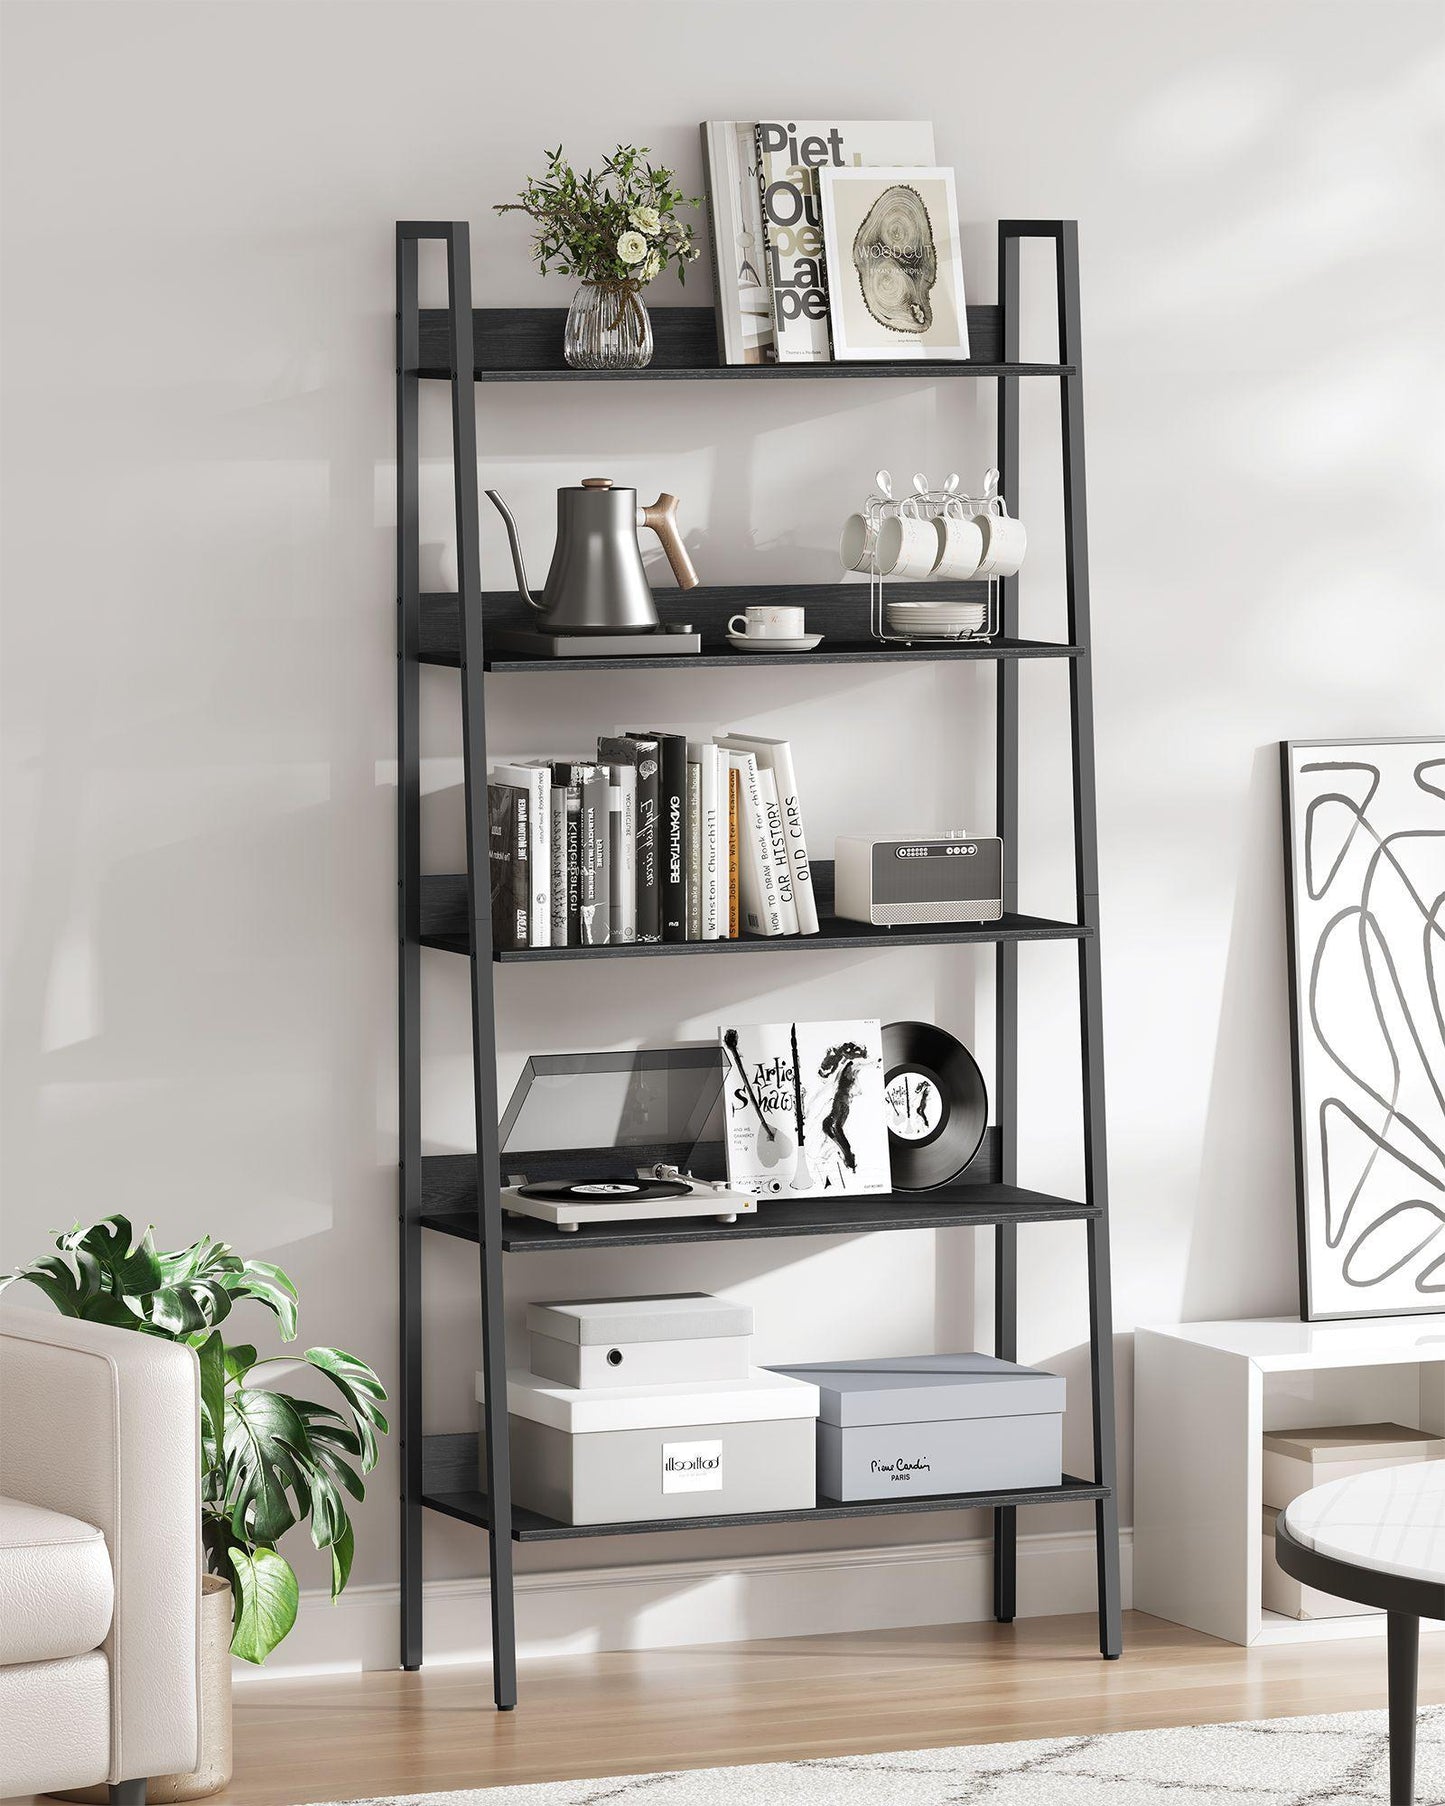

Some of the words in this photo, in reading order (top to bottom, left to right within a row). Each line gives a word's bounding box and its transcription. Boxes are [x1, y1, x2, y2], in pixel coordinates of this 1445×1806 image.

[760, 123, 845, 168] Piet
[760, 173, 771, 253] Oudolf
[858, 244, 931, 258] WOODCUT
[748, 758, 759, 807] children
[691, 810, 698, 819] in
[785, 795, 802, 838] CARS
[691, 823, 699, 869] arrangement
[708, 808, 717, 873] Churchill
[759, 836, 768, 860] Book
[766, 802, 787, 866] HISTORY
[691, 873, 698, 882] an
[729, 862, 737, 872] by
[764, 865, 773, 890] DRAW
[795, 849, 810, 881] OLD
[769, 894, 776, 906] TO
[780, 874, 792, 902] CAR
[691, 907, 698, 916] to
[708, 880, 716, 931] Winston
[752, 1057, 794, 1089] Artie
[731, 1085, 793, 1118] Shaw
[890, 1473, 911, 1481] PARIS
[896, 1456, 931, 1472] Cardin
